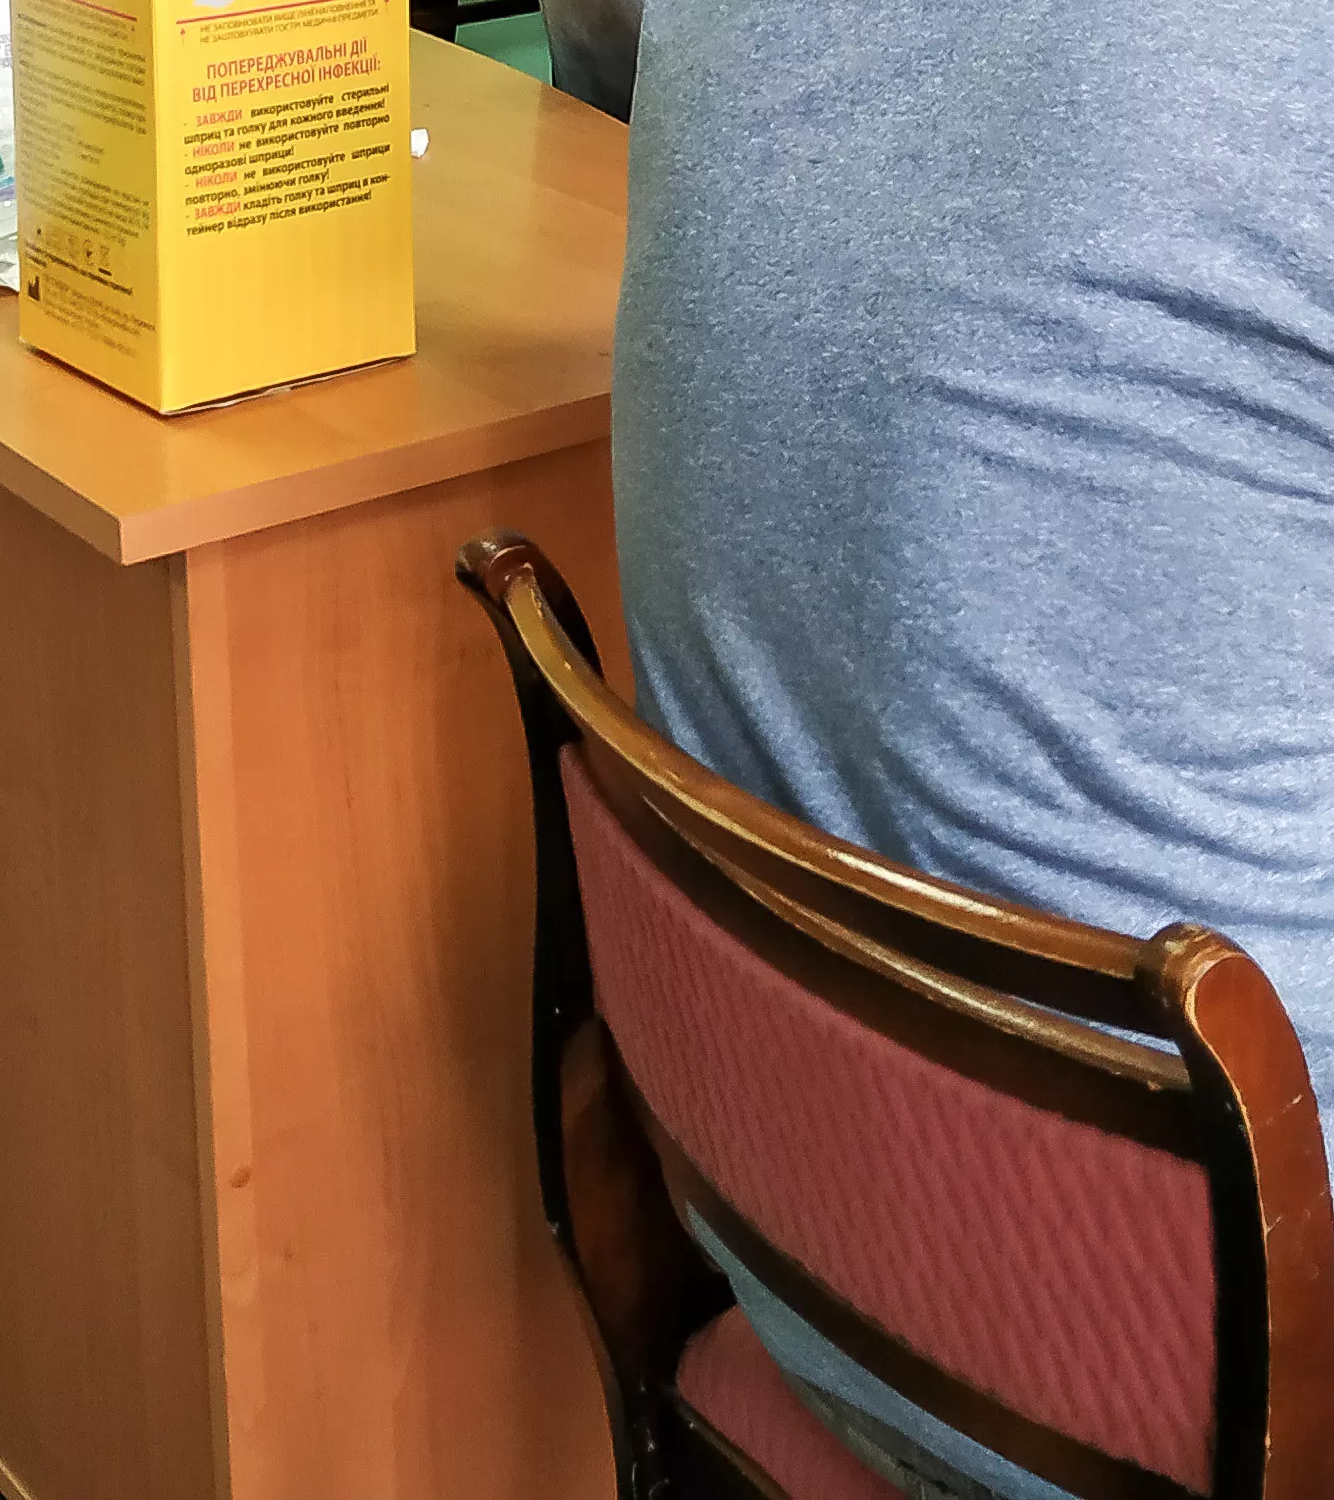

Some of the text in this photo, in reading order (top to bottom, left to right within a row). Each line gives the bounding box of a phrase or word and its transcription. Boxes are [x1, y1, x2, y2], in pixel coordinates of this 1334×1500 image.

[192, 55, 381, 104] ВІД ПЕРЕХРЕСНОЇ ІНФЕКЦІЇ:
[206, 37, 367, 80] ПОПЕРЕДЖУВАЛЬНІ ДІЇ
[196, 82, 390, 127] ЗАВЖДИ використовуйте стерильні
[184, 130, 221, 145] шприц
[223, 128, 235, 138] та
[237, 121, 267, 136] голку
[268, 118, 287, 131] для
[290, 111, 333, 126] кожного
[192, 114, 390, 158] НІКОЛИ не використовуйте повторно
[184, 154, 247, 176] одноразові
[195, 143, 391, 188] НІКОЛИ не використовуйте шприци
[186, 222, 225, 237] тейнер
[227, 213, 267, 229] відразу
[195, 202, 241, 220] ЗАВЖДИ
[243, 194, 283, 211] кладіть
[284, 188, 313, 204] голку
[315, 187, 326, 197] та
